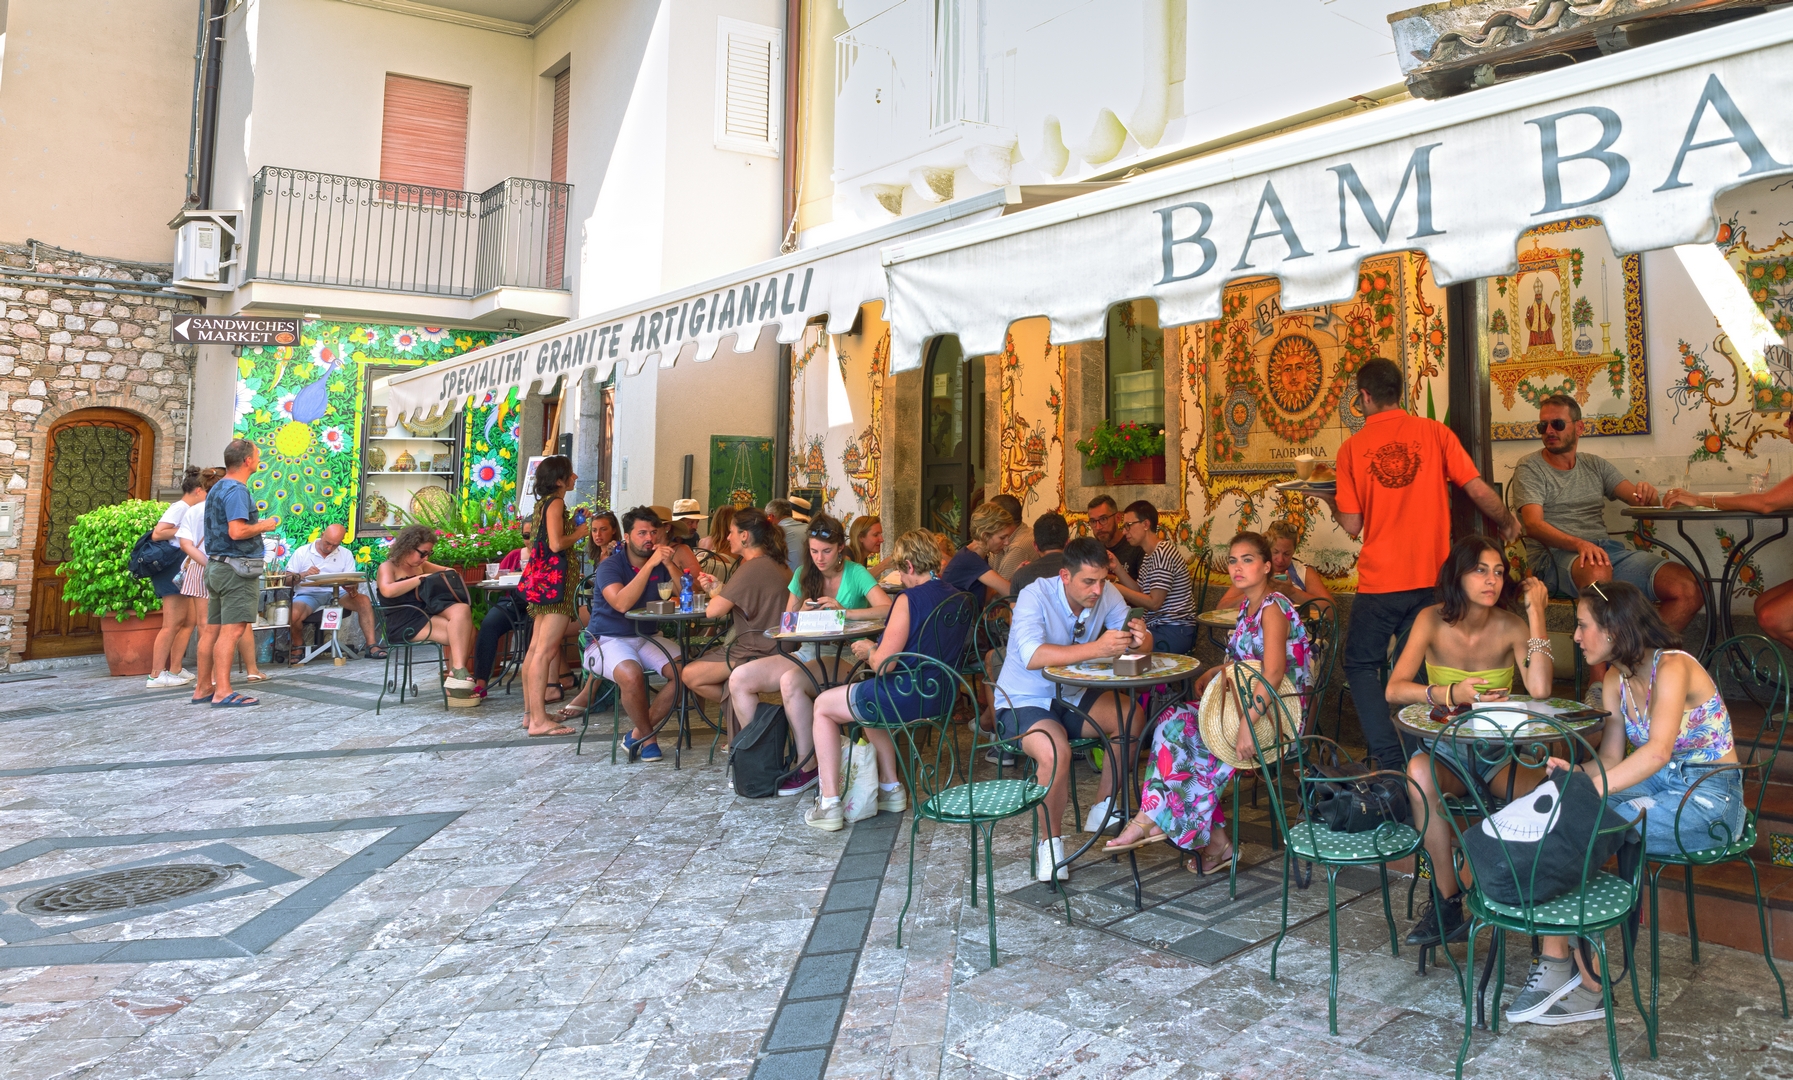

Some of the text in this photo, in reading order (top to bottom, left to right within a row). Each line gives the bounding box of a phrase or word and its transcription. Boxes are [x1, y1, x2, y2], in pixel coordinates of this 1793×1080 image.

[1153, 142, 1447, 287] BAM
[192, 318, 295, 333] SANDWICHES
[536, 323, 624, 375] GRANITE
[630, 267, 814, 353] ARTIGIANALI
[197, 330, 272, 343] MARKET
[1269, 446, 1328, 459] TAORMINA
